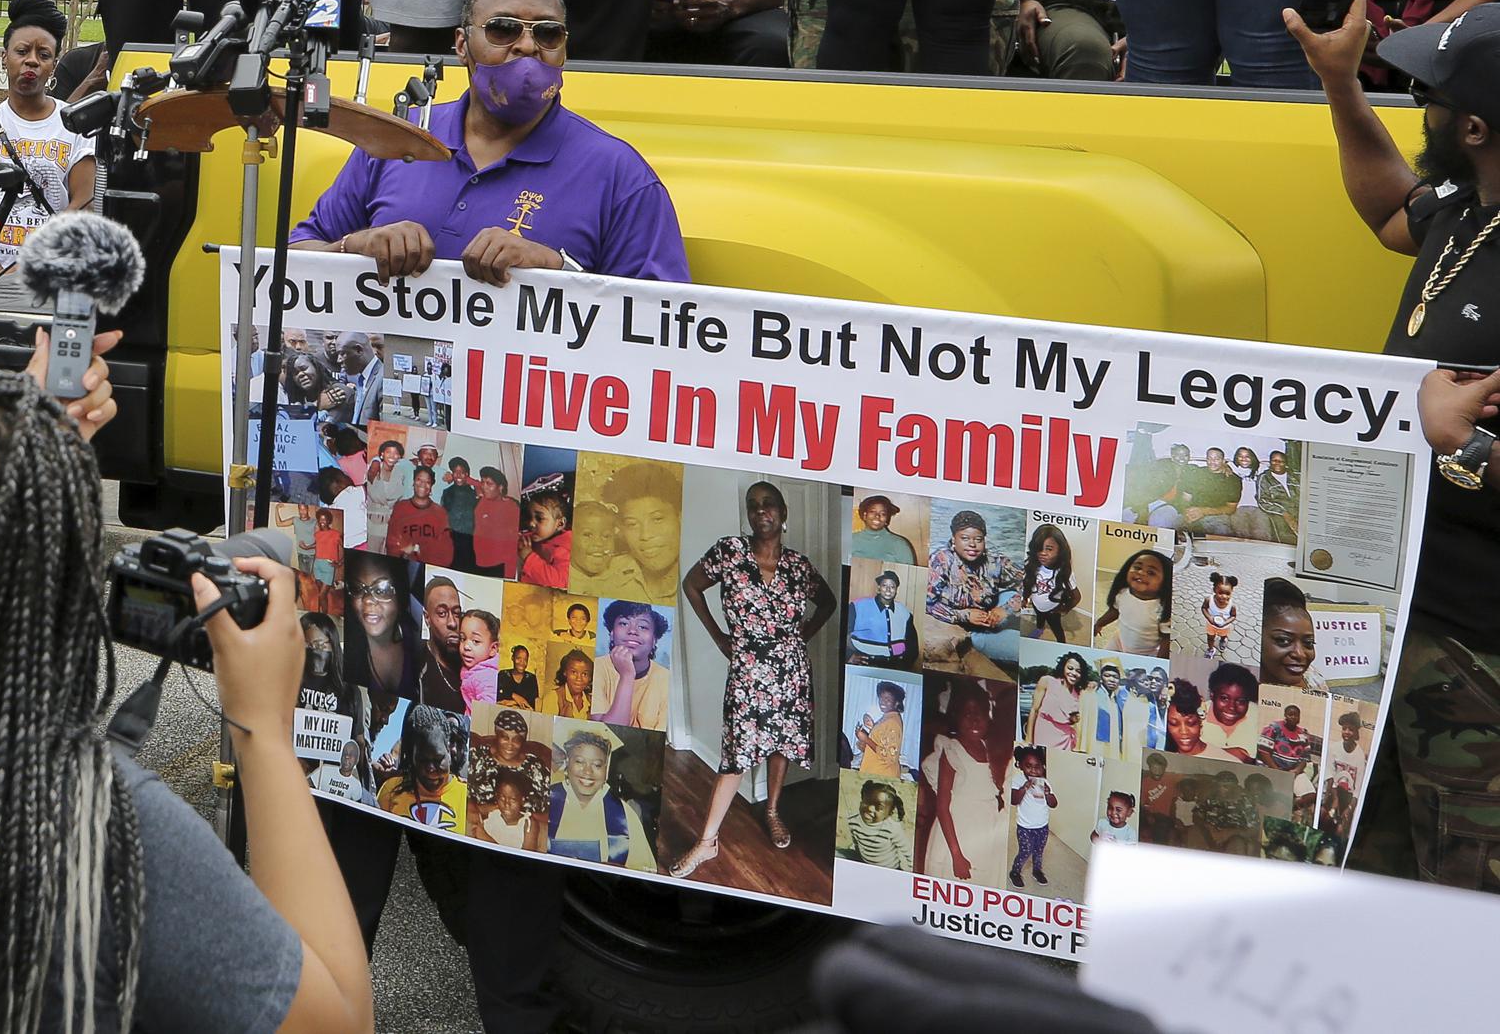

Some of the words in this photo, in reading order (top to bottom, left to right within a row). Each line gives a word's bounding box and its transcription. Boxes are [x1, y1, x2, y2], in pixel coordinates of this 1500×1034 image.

[27, 217, 48, 226] BEE
[233, 262, 334, 315] You
[355, 272, 494, 327] Stole
[516, 285, 601, 350] My
[622, 296, 728, 353] Life
[752, 309, 856, 370] But
[880, 323, 992, 385] Not
[1015, 338, 1112, 410] My
[1136, 351, 1412, 442] Legacy.
[465, 348, 485, 420] I
[500, 353, 629, 437] live
[648, 369, 717, 450] In
[736, 379, 840, 471] My
[859, 395, 1119, 508] Family
[1032, 509, 1090, 532] Serenity
[1105, 524, 1159, 544] Londyn
[1316, 621, 1368, 631] JUSTICE
[1334, 637, 1356, 646] FOR
[1325, 656, 1370, 666] PAMELA
[301, 688, 326, 708] STICE
[1261, 699, 1282, 707] NaNa
[1302, 688, 1329, 699] Sisters
[304, 716, 318, 731] MY
[322, 719, 339, 734] LIFE
[296, 733, 342, 753] MATTERED
[329, 778, 350, 790] Justice
[912, 876, 974, 908] END
[983, 889, 1091, 930] POLICE
[912, 903, 1013, 942] Justice
[1021, 923, 1063, 951] for
